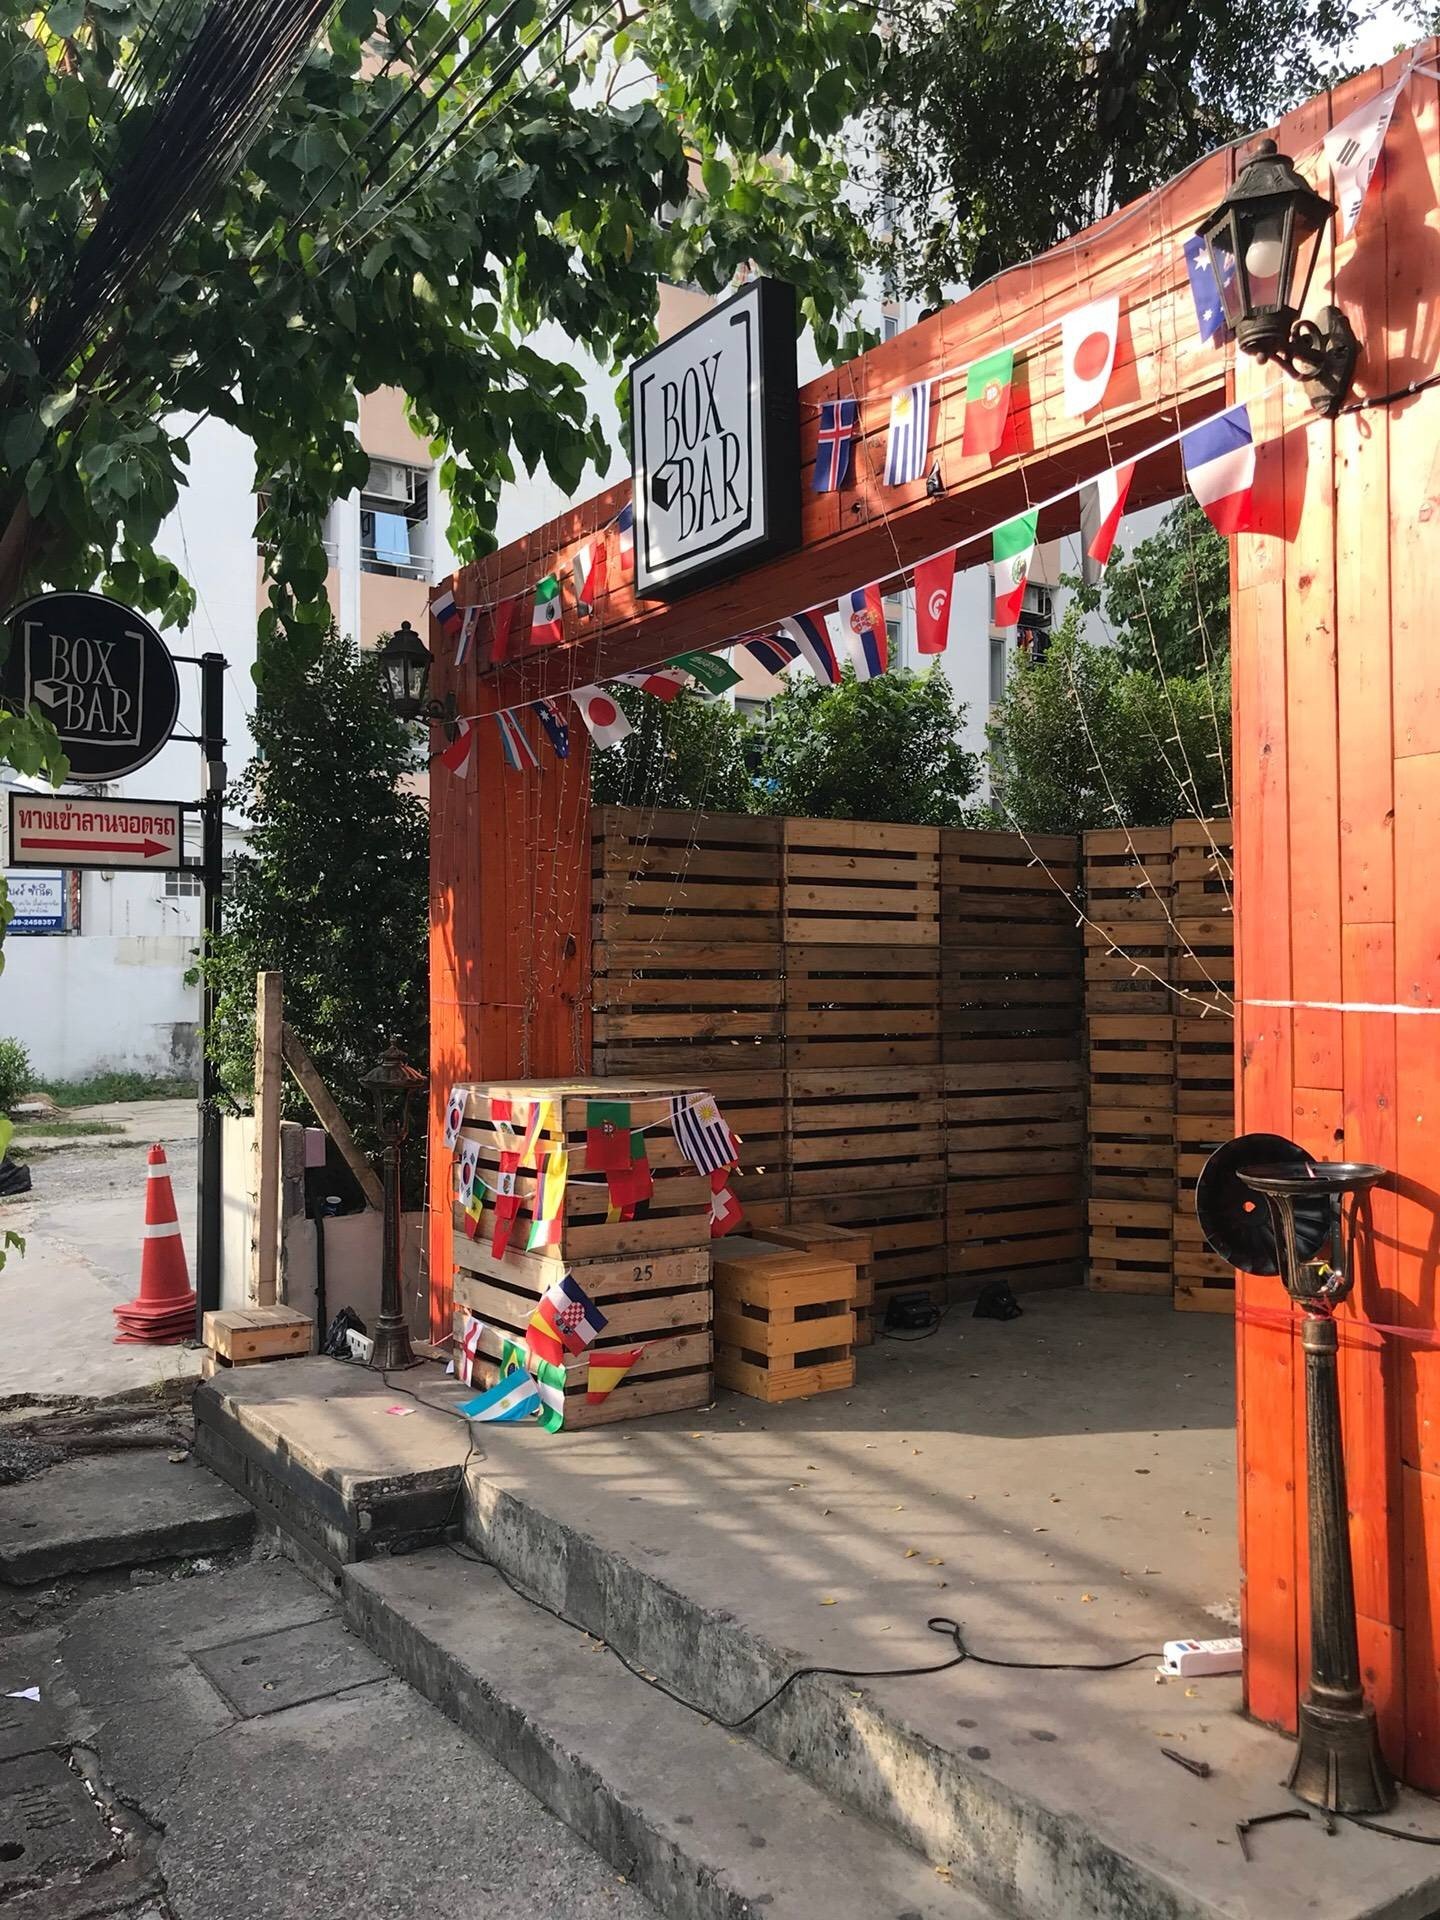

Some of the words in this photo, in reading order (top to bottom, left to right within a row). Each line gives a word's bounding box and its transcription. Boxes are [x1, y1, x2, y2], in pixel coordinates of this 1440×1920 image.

[661, 350, 725, 463] BOX
[678, 432, 744, 541] BAR
[49, 634, 117, 688] BOX
[63, 684, 132, 735] BAR
[18, 803, 175, 836] ทางเข้าลานจอดรถ
[633, 1265, 654, 1282] 25
